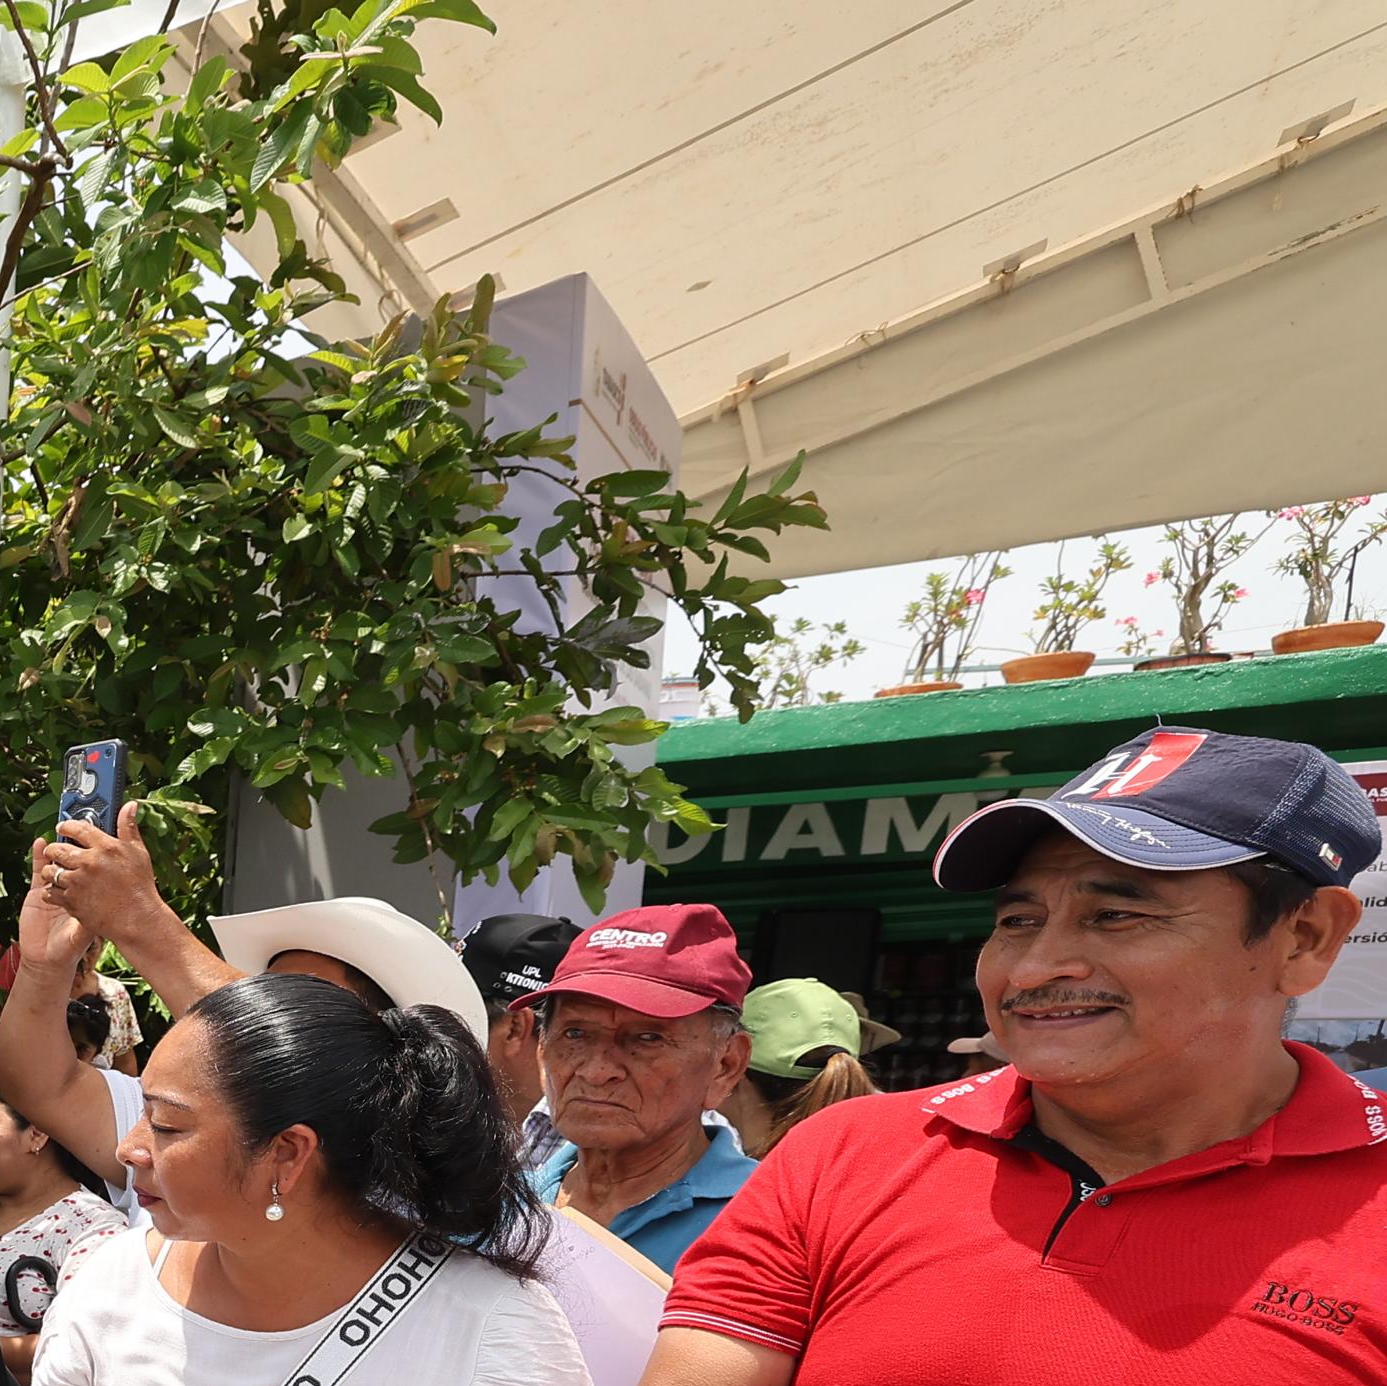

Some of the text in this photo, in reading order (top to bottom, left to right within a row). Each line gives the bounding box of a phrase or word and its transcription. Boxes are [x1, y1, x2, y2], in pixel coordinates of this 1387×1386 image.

[649, 787, 1063, 866] DIAM
[589, 928, 667, 944] CENTRO
[522, 964, 542, 978] UPL
[1251, 1302, 1345, 1335] HUGO BOSS
[1262, 1281, 1358, 1325] BOSS
